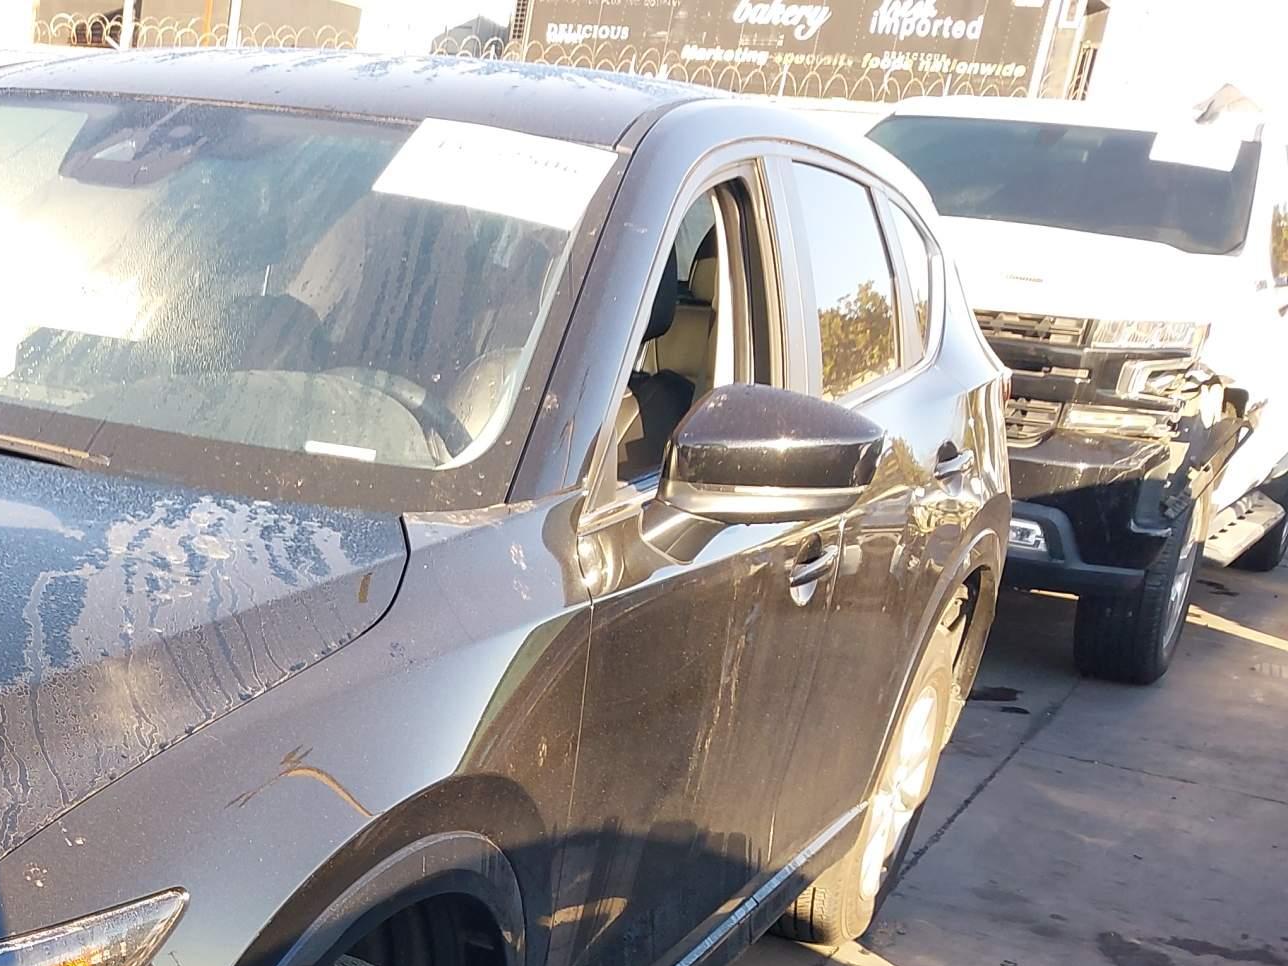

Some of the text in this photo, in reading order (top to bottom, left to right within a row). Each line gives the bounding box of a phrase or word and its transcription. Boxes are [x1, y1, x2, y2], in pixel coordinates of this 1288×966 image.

[547, 22, 630, 41] DELICIOUS
[733, 0, 832, 40] bakery
[869, 10, 985, 40] imported
[681, 44, 770, 66] Marketing
